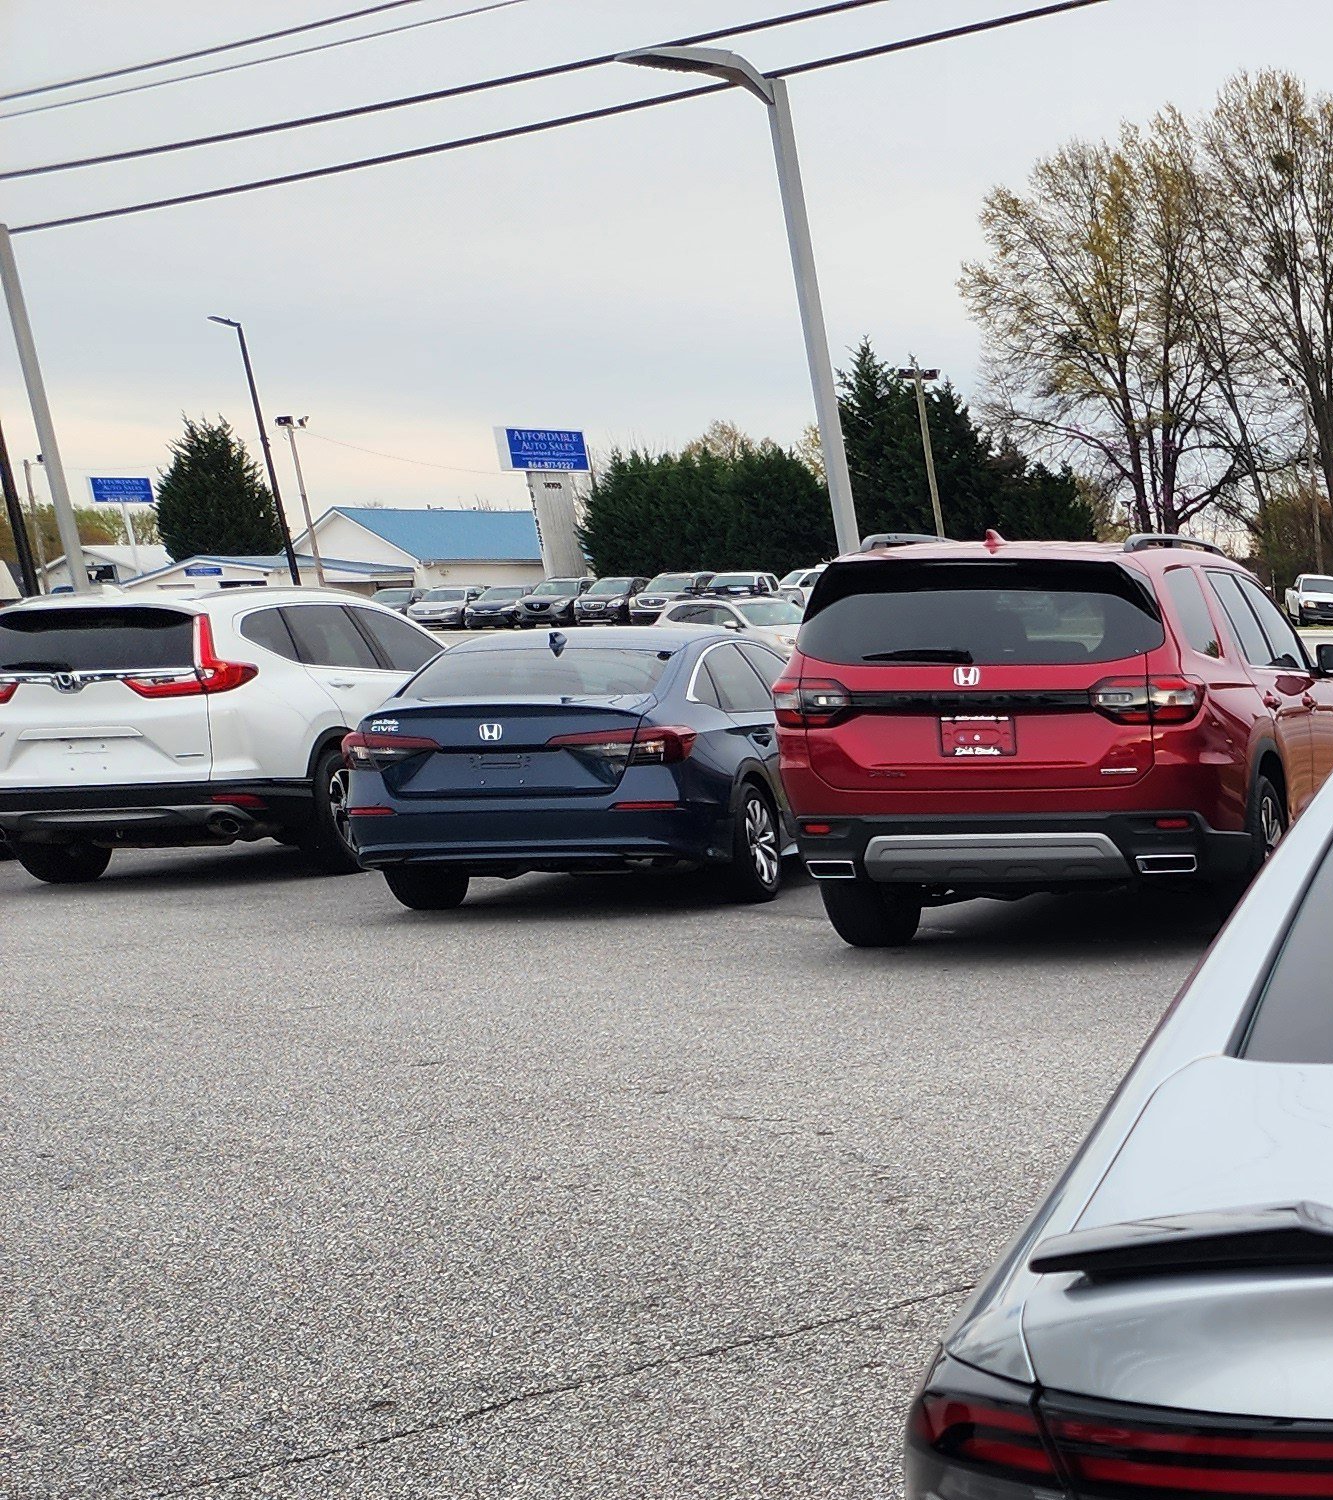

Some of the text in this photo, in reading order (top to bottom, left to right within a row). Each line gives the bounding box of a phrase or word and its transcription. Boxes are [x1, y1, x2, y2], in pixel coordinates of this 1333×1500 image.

[513, 430, 579, 442] AFFORDABLE
[521, 440, 575, 451] AUTO SALES
